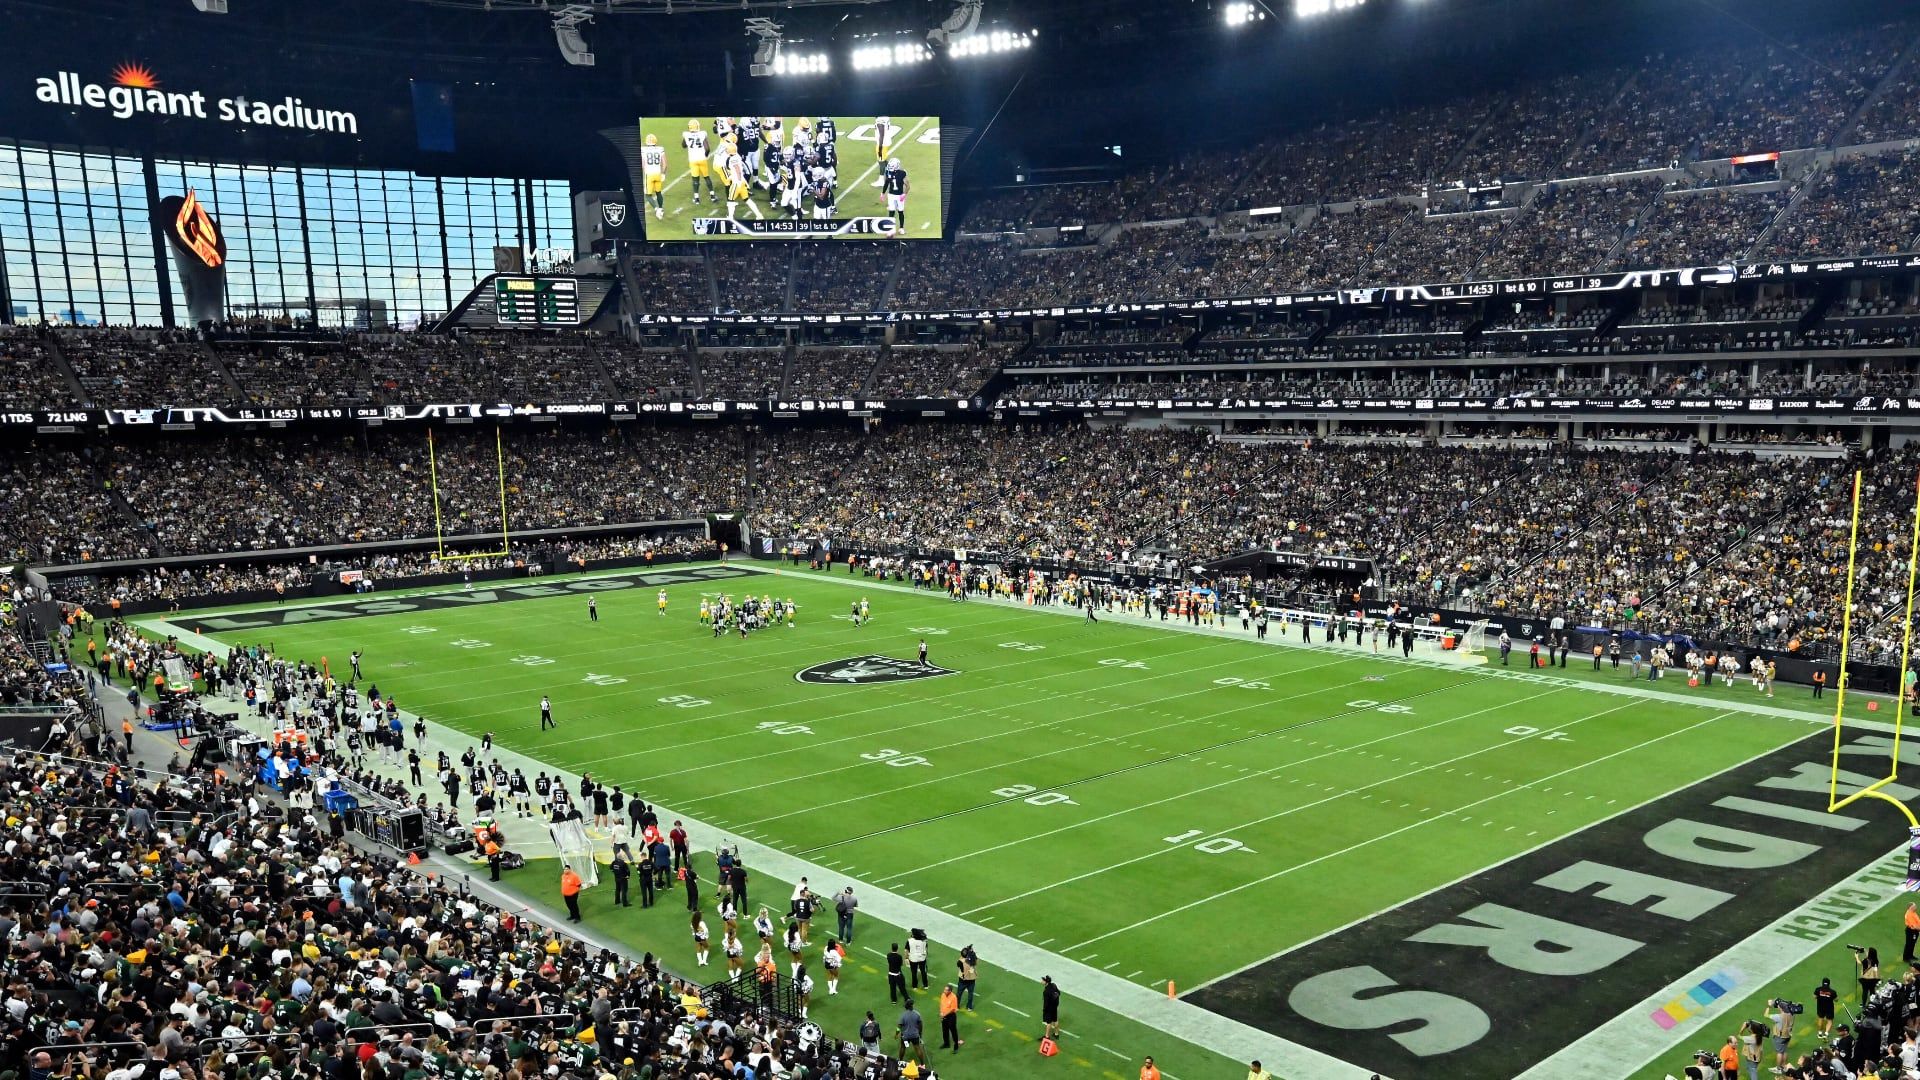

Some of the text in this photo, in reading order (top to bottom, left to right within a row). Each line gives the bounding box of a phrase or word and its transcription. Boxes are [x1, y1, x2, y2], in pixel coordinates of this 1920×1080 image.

[36, 71, 357, 133] allegiant stadium
[688, 138, 703, 149] 74
[646, 152, 660, 166] 88
[523, 247, 575, 265] MGM
[1468, 285, 1493, 295] 14:53
[1519, 284, 1524, 292] &
[1527, 283, 1536, 291] 10
[1589, 279, 1601, 288] 39
[270, 410, 298, 418] 14:53
[390, 407, 403, 419] 39
[547, 405, 602, 413] SCOREBOARD
[9, 414, 33, 422] TDS
[47, 413, 87, 422] 72 LNG
[197, 568, 748, 630] LAS VEGAS
[581, 671, 628, 685] 40
[1212, 678, 1272, 692] 30
[658, 694, 711, 710] 50
[758, 722, 811, 736] 40
[1503, 725, 1568, 741] 10
[860, 749, 928, 767] 30
[496, 774, 506, 785] 87
[511, 777, 520, 788] 77
[538, 783, 548, 792] 71
[556, 794, 565, 804] 61
[990, 784, 1071, 806] 20
[1162, 830, 1245, 855] 10
[1774, 888, 1881, 943] CATCH
[1042, 1041, 1050, 1054] G
